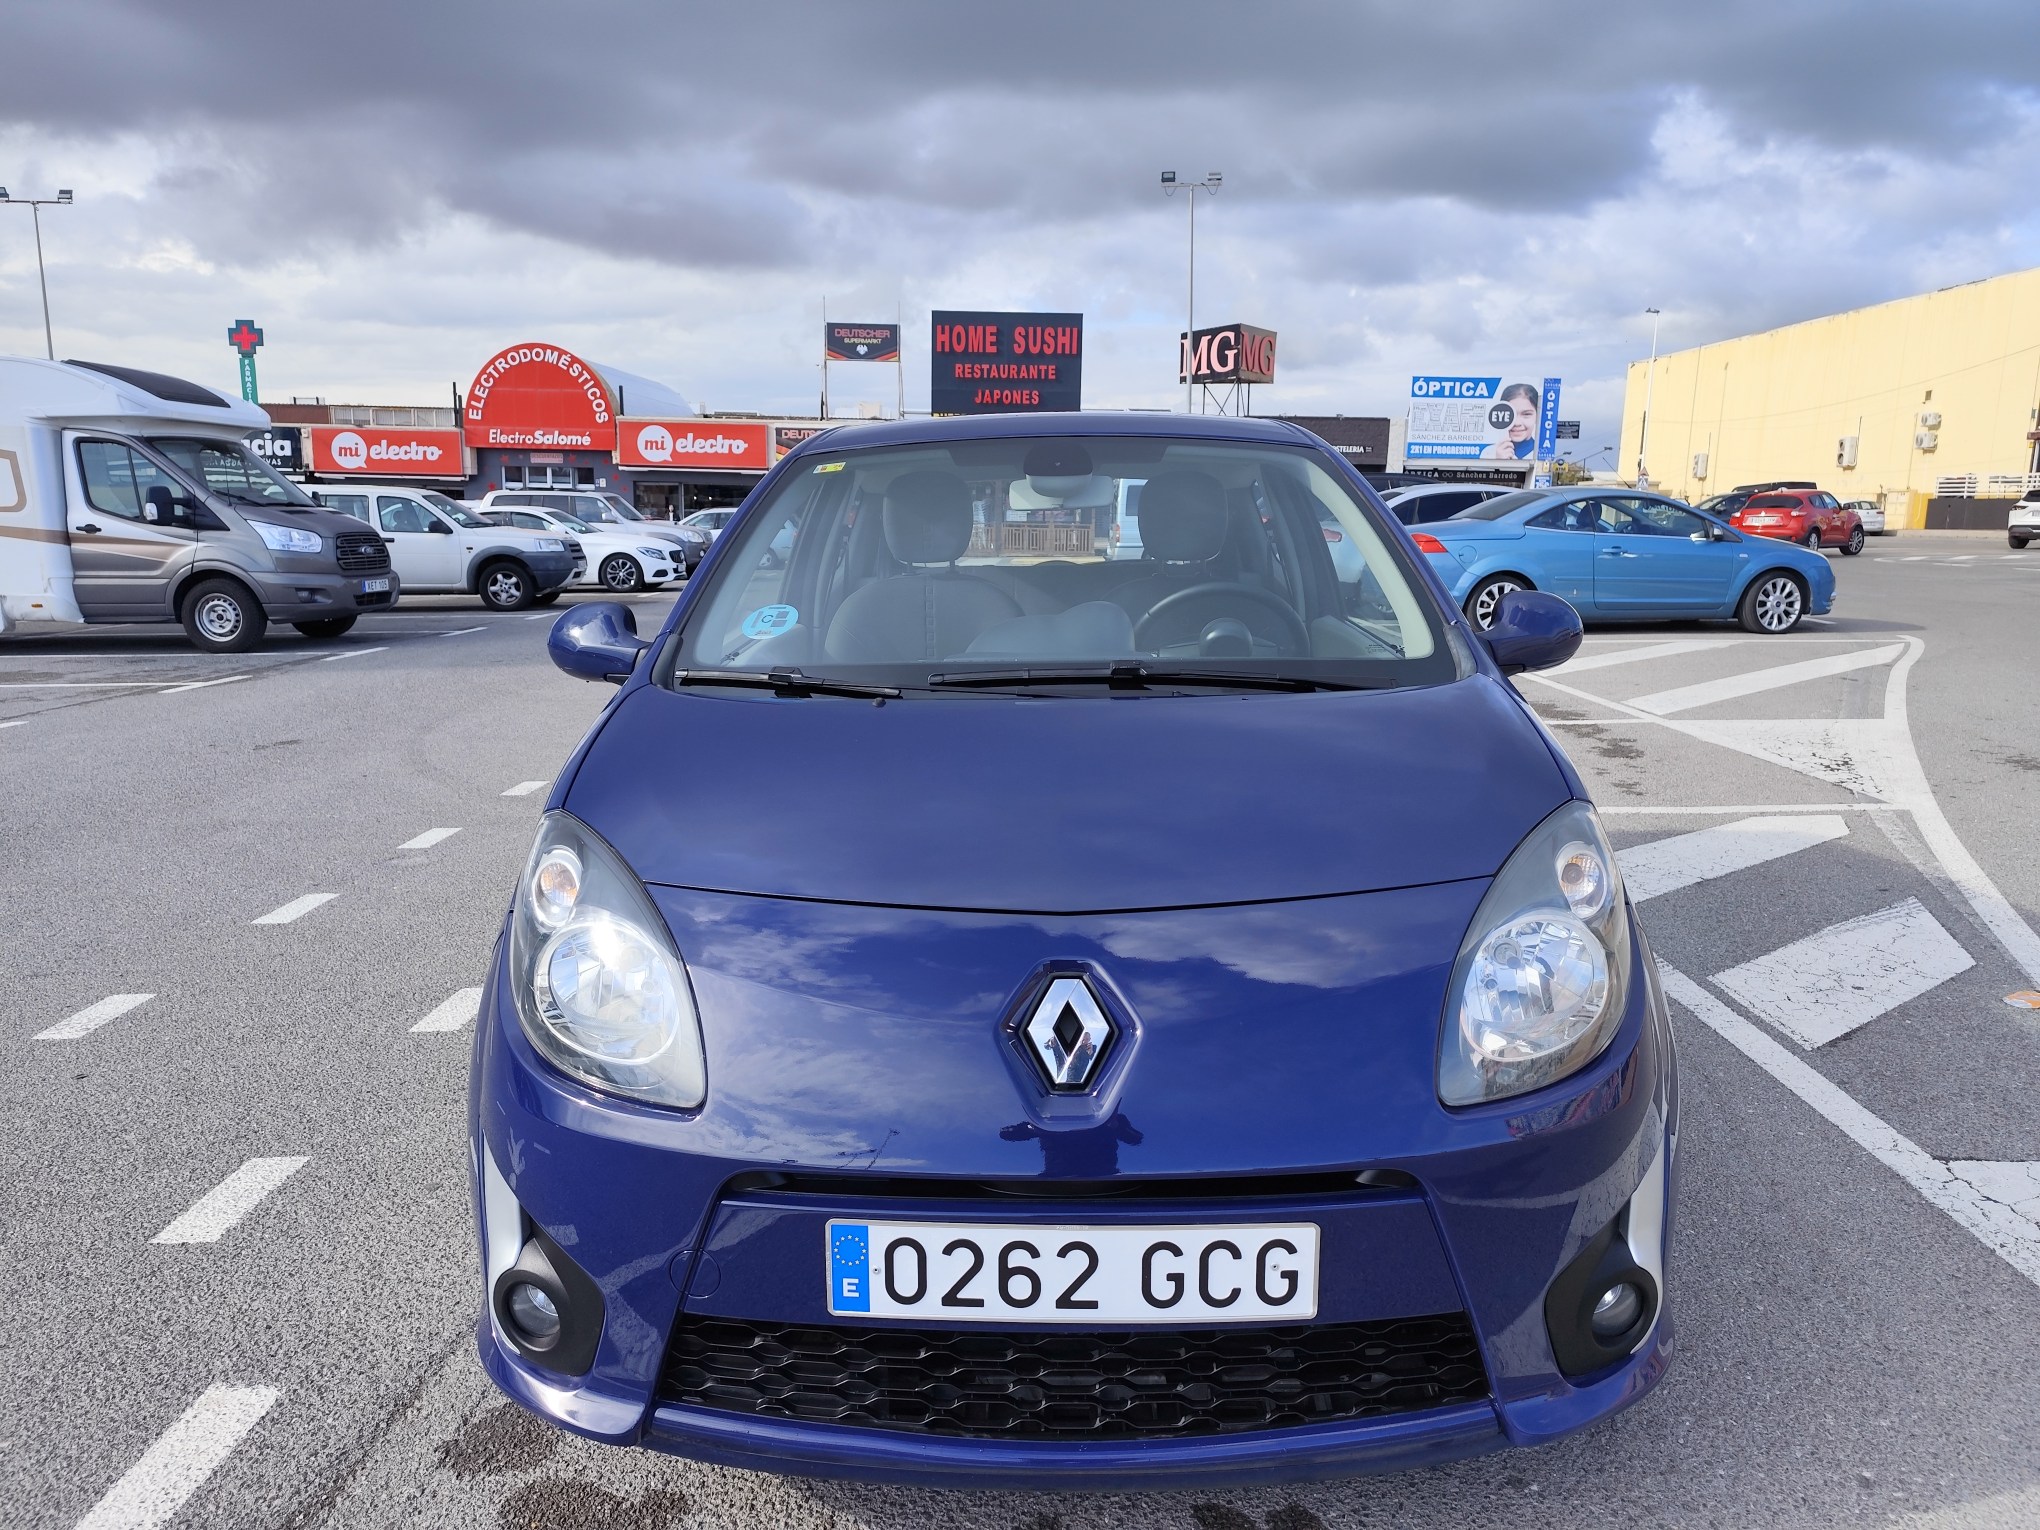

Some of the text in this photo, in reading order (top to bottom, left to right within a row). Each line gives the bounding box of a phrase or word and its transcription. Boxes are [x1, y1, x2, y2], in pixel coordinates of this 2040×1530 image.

[835, 328, 890, 338] DEUTSCHER
[936, 325, 1078, 355] HOME SUSHI
[1180, 331, 1238, 377] MG
[1241, 330, 1275, 376] MG
[955, 363, 1056, 379] RESTAURANTE
[468, 347, 609, 424] ELECTRODOMÉSTICOS
[1413, 378, 1489, 397] ÓPTICA
[974, 389, 1040, 405] JAPONES
[1491, 410, 1511, 422] EYE
[489, 428, 591, 446] ElectroSalomé
[644, 432, 748, 455] mi electro
[1447, 434, 1484, 442] BARREDO
[338, 439, 442, 461] mi electro
[1410, 445, 1480, 455] 2X1 EN PROGRESIVOS
[842, 1278, 860, 1298] E
[884, 1236, 1099, 1310] 0262
[1141, 1238, 1299, 1310] GCG
